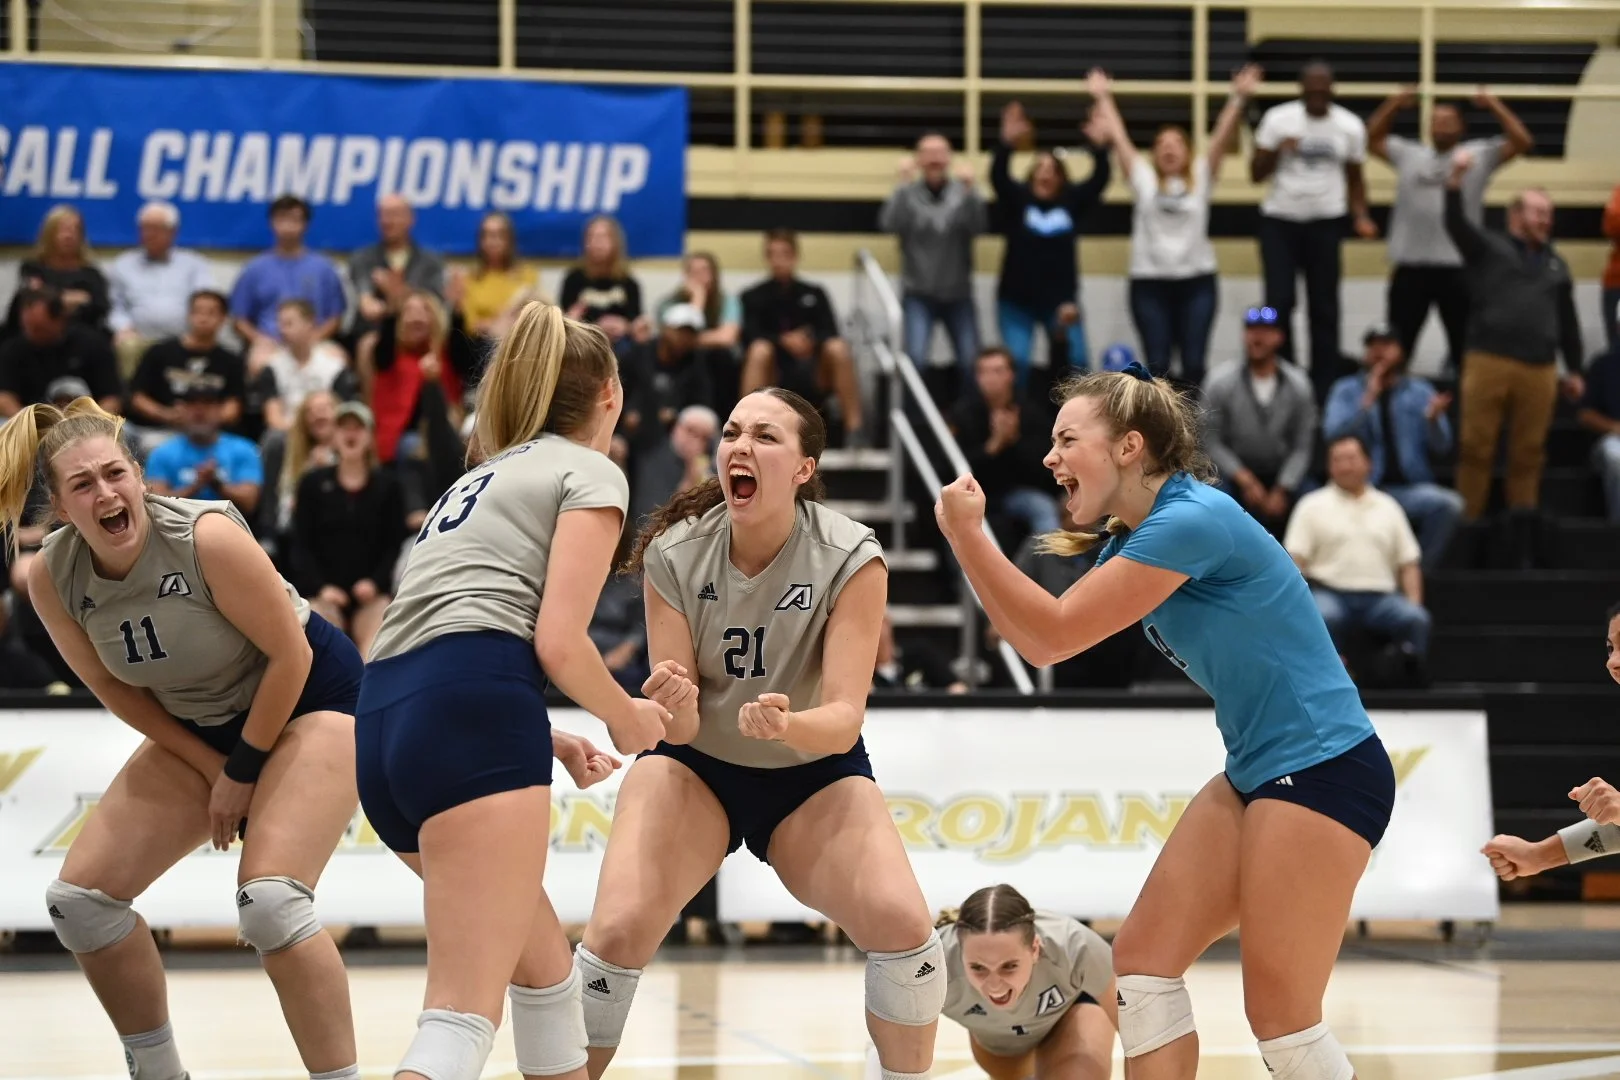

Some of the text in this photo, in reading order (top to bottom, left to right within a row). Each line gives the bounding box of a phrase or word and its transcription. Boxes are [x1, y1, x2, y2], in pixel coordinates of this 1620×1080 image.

[137, 129, 651, 212] CHAMPIONSHIP
[119, 615, 169, 664] 11
[722, 626, 767, 680] 21
[882, 790, 1192, 864] ROJAN
[587, 982, 611, 995] adidas
[914, 966, 935, 979] adidas
